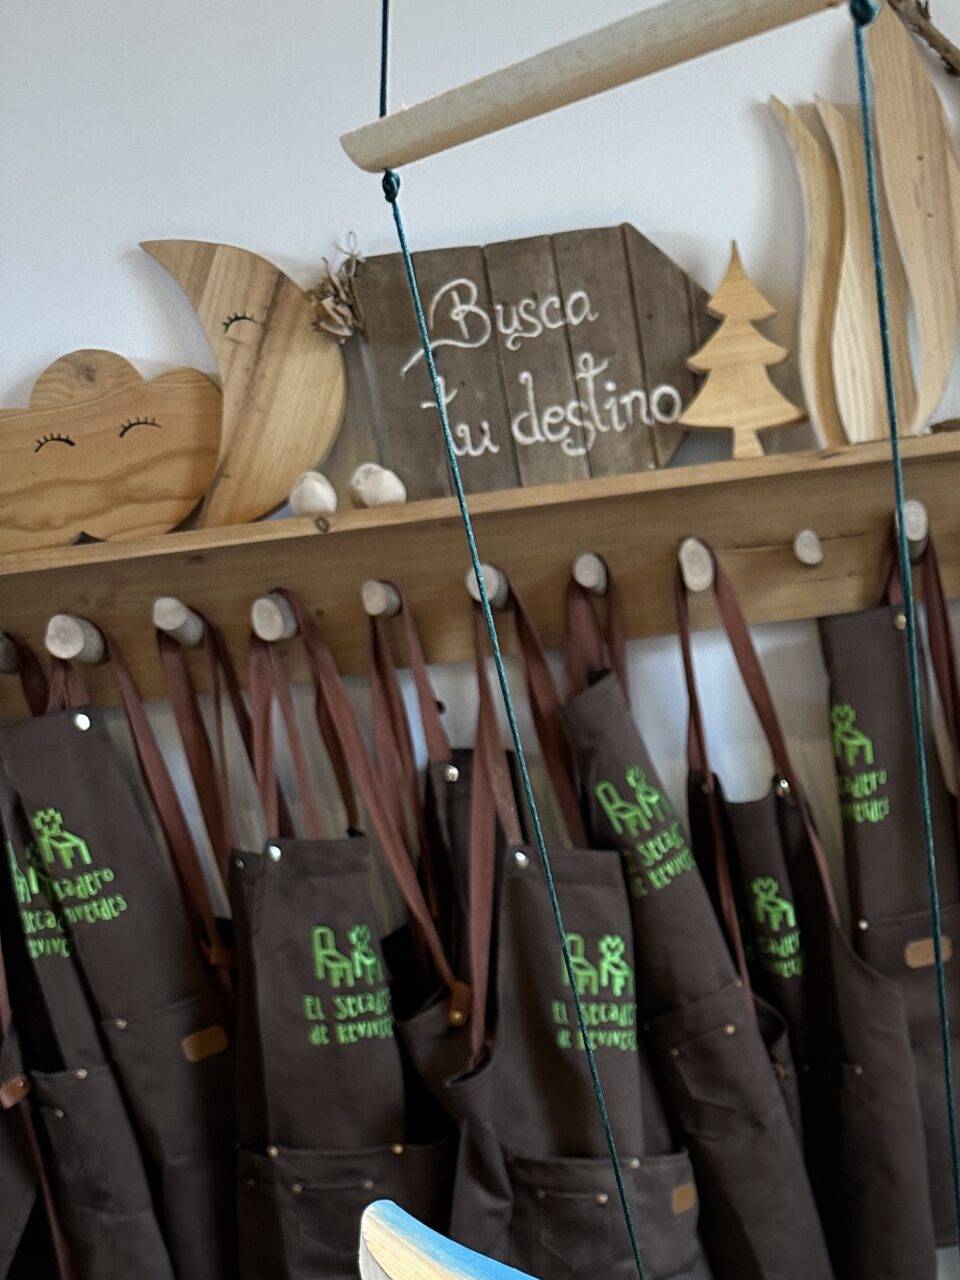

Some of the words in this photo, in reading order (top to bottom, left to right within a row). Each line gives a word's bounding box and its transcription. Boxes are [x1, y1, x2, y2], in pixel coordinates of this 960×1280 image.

[402, 277, 600, 376] Busca
[420, 375, 500, 457] tu
[511, 352, 683, 457] destino
